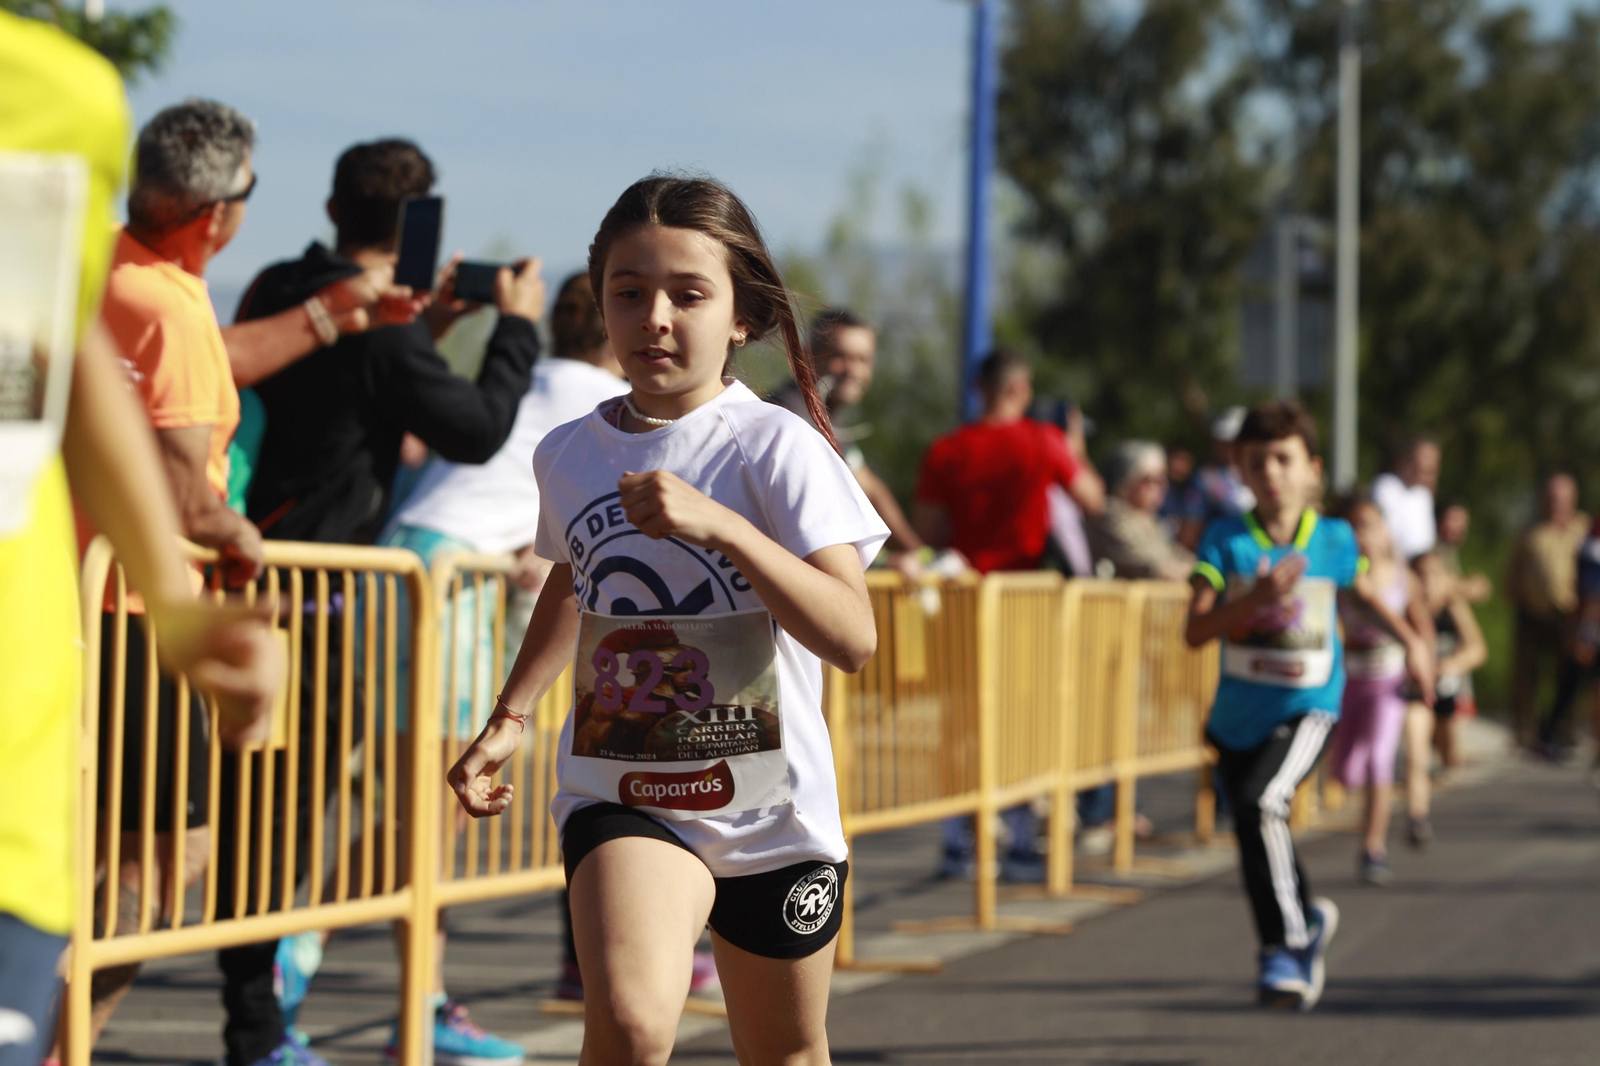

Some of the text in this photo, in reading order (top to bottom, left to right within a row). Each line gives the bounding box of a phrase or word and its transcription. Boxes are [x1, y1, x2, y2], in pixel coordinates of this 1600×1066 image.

[616, 622, 652, 631] VALERIA
[592, 647, 715, 713] 823
[676, 704, 757, 726] XIII
[676, 722, 759, 735] CARRERA
[678, 731, 758, 744] POPULAR
[695, 738, 760, 750] ESPARTANOS
[678, 751, 702, 760] DEL
[790, 881, 807, 902] CLUB
[791, 919, 816, 931] STELLA
